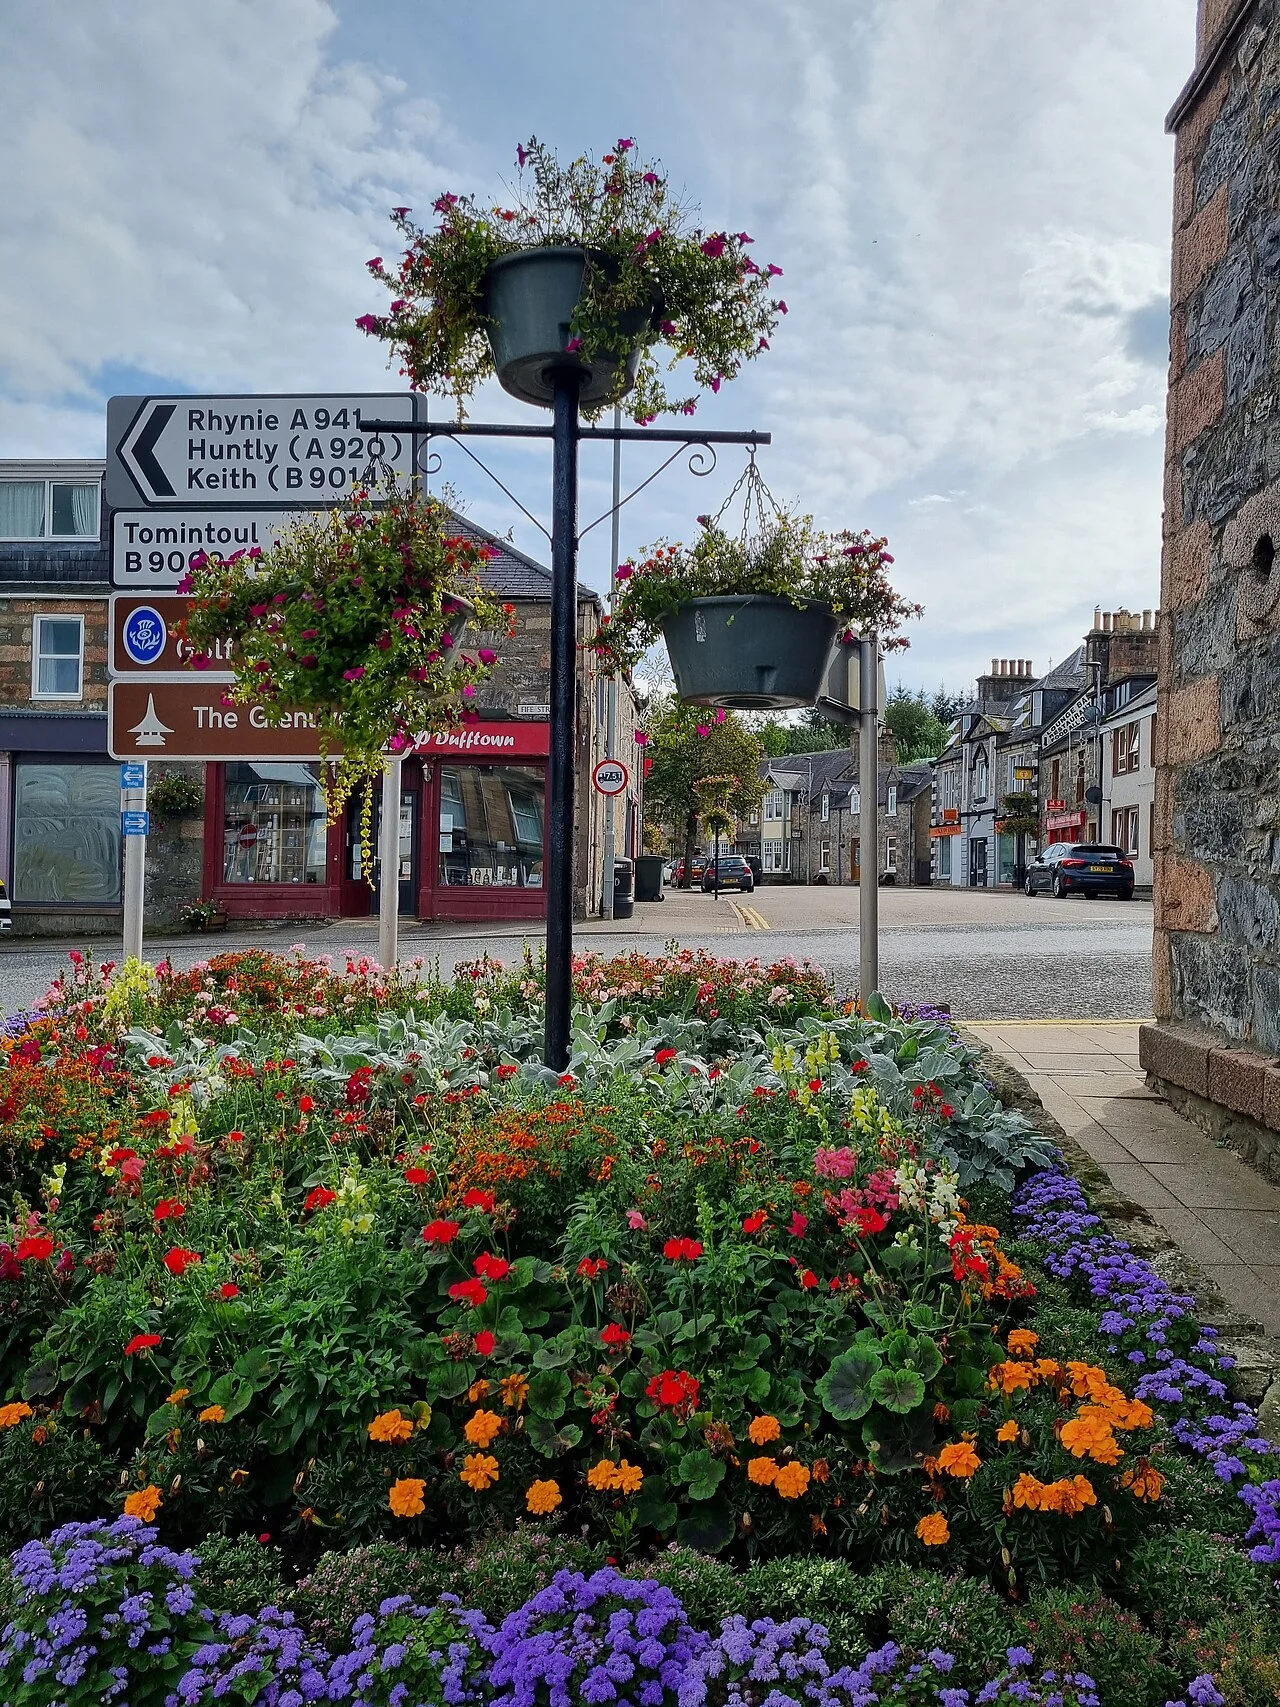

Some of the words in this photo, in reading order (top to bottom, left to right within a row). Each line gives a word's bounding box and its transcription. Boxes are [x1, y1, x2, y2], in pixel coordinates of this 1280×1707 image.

[188, 409, 280, 435] Rhynie
[188, 438, 279, 464] Huntly
[187, 467, 257, 489] Keith
[124, 522, 259, 544] Tomintoul
[192, 706, 239, 729] The
[435, 730, 515, 749] Dufftown
